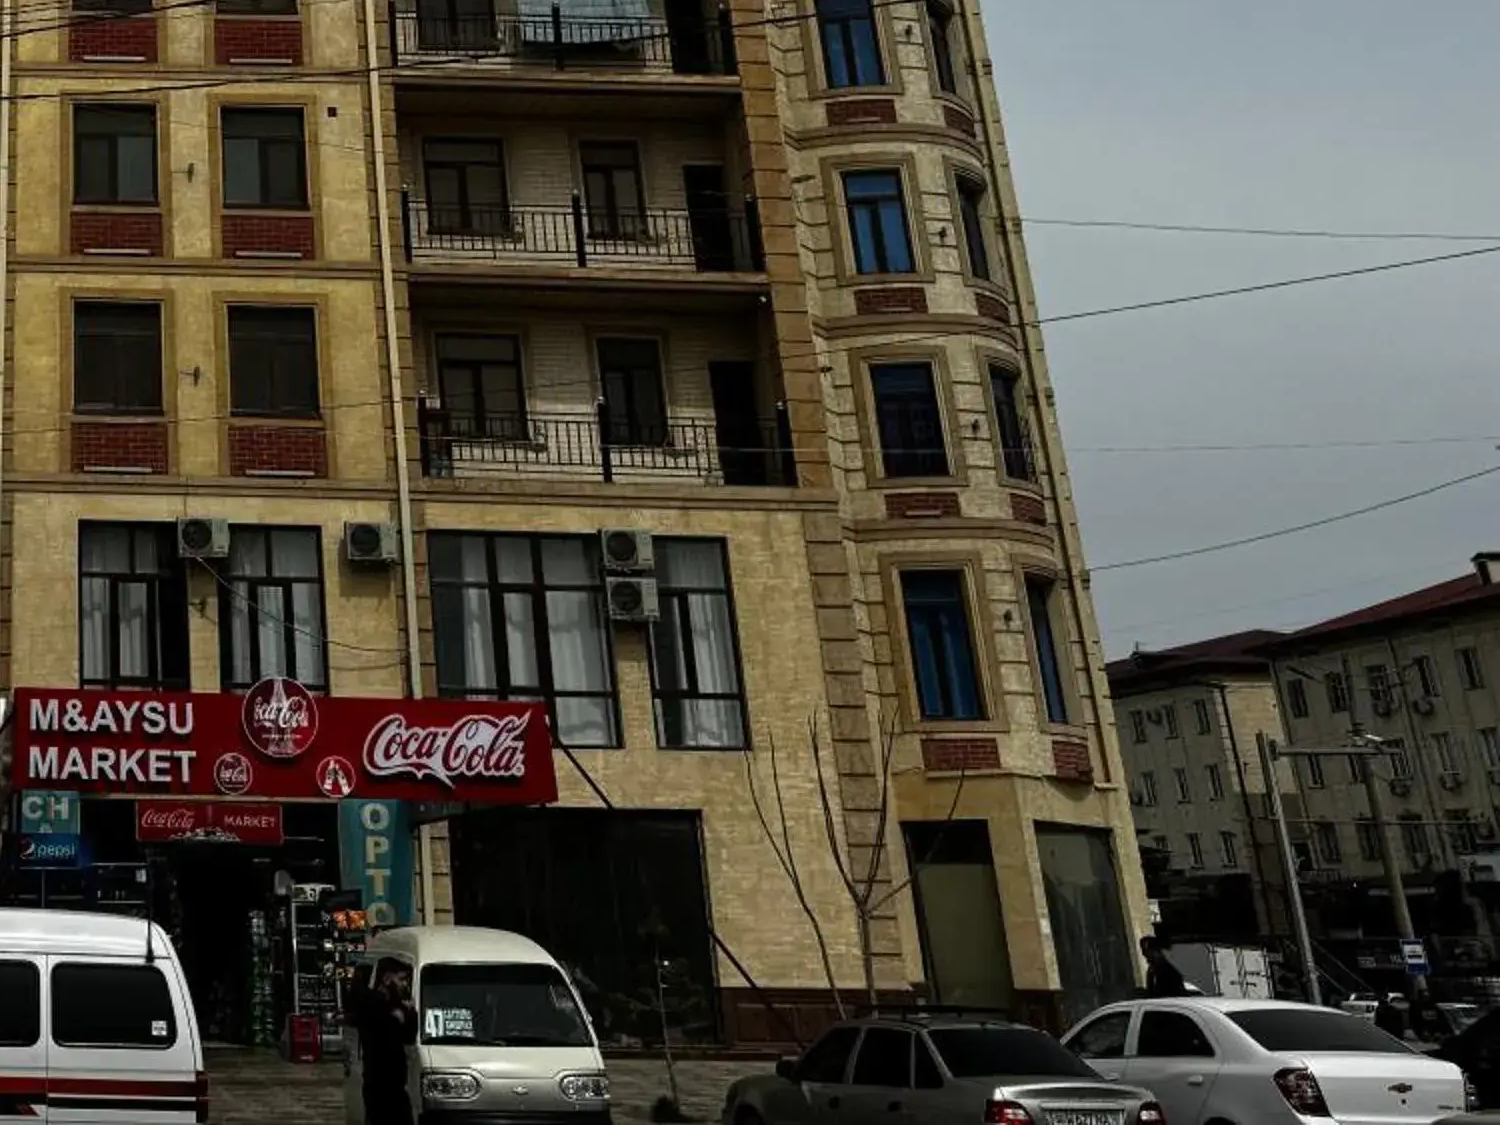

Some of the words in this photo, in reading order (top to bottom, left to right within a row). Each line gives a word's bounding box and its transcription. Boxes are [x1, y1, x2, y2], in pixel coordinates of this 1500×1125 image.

[29, 698, 194, 735] M&AYSU
[28, 745, 198, 784] MARKET
[363, 709, 532, 786] Coca-Cola
[223, 814, 276, 828] MARKET
[37, 841, 76, 859] pepsi
